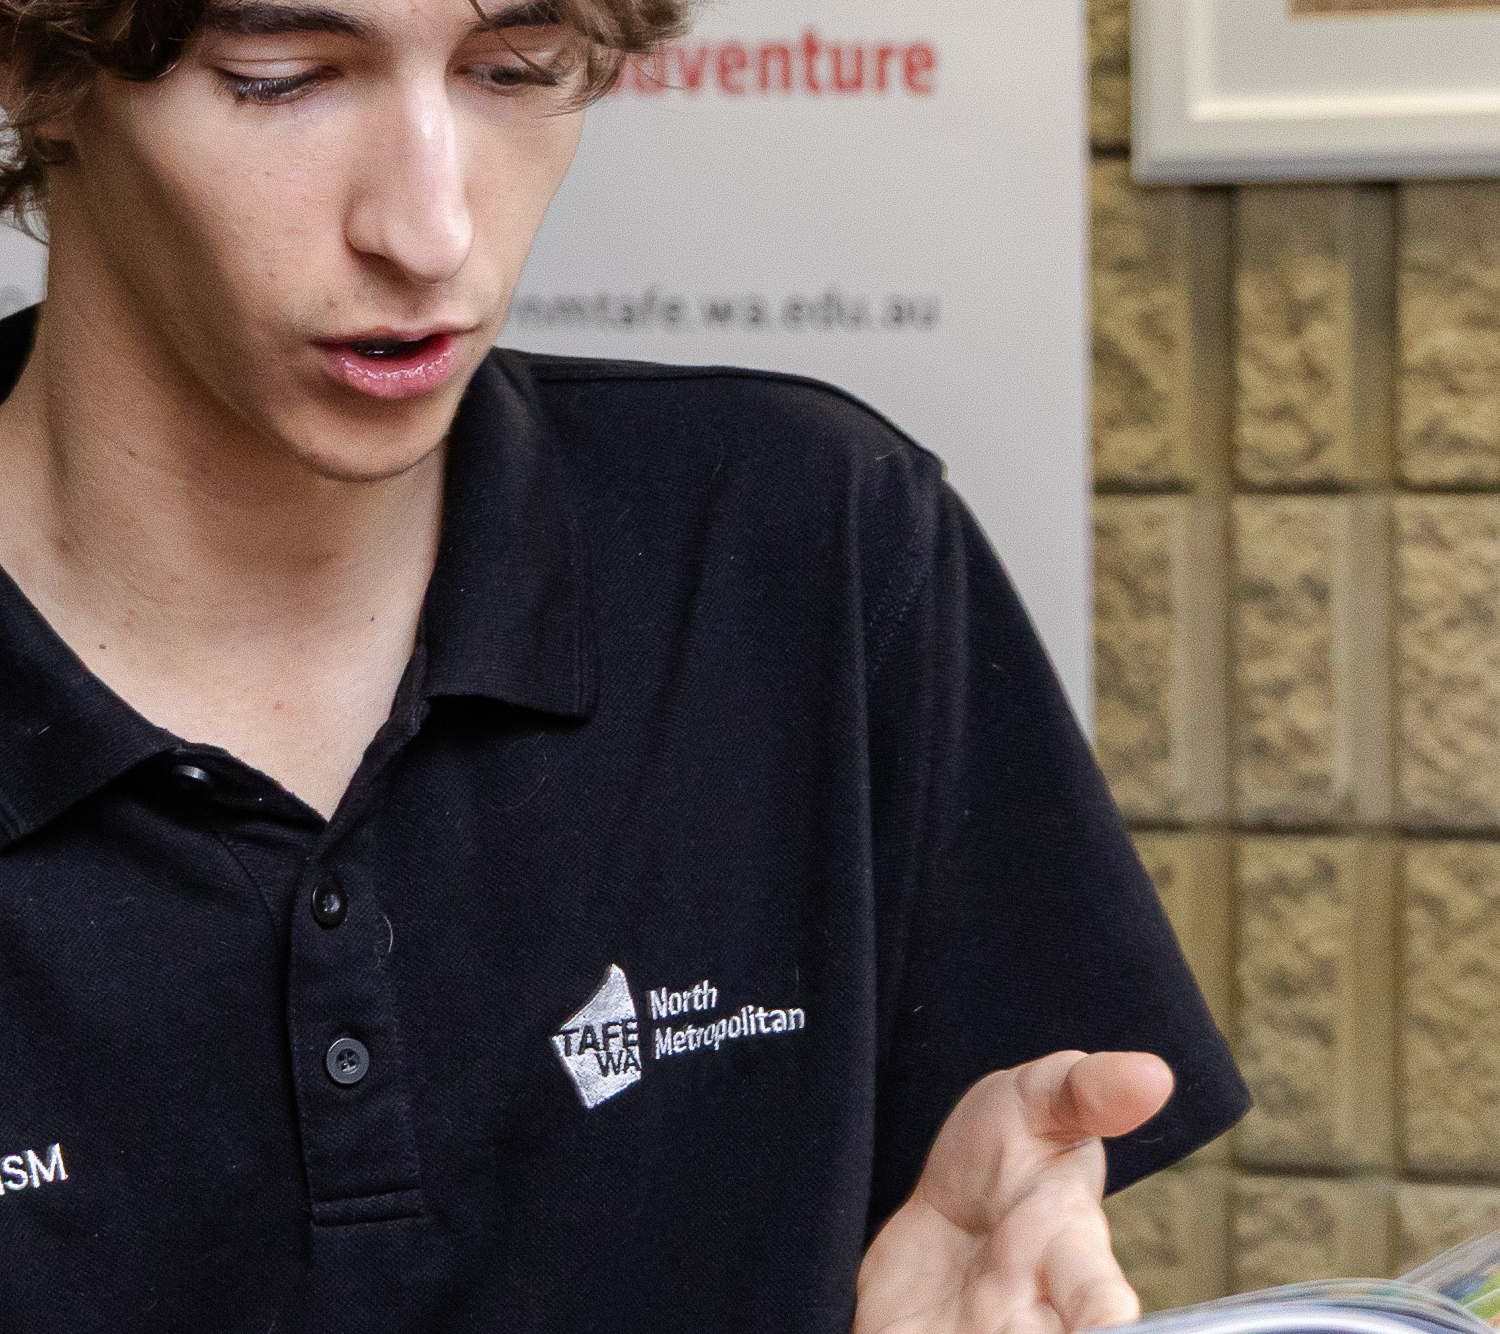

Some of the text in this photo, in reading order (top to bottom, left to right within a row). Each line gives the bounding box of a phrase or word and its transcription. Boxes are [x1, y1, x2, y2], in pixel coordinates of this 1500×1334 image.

[614, 27, 937, 95] dventure
[649, 979, 719, 1021] North
[554, 1017, 640, 1058] TAFE
[653, 1004, 806, 1060] Metropolitan
[596, 1049, 642, 1078] WA
